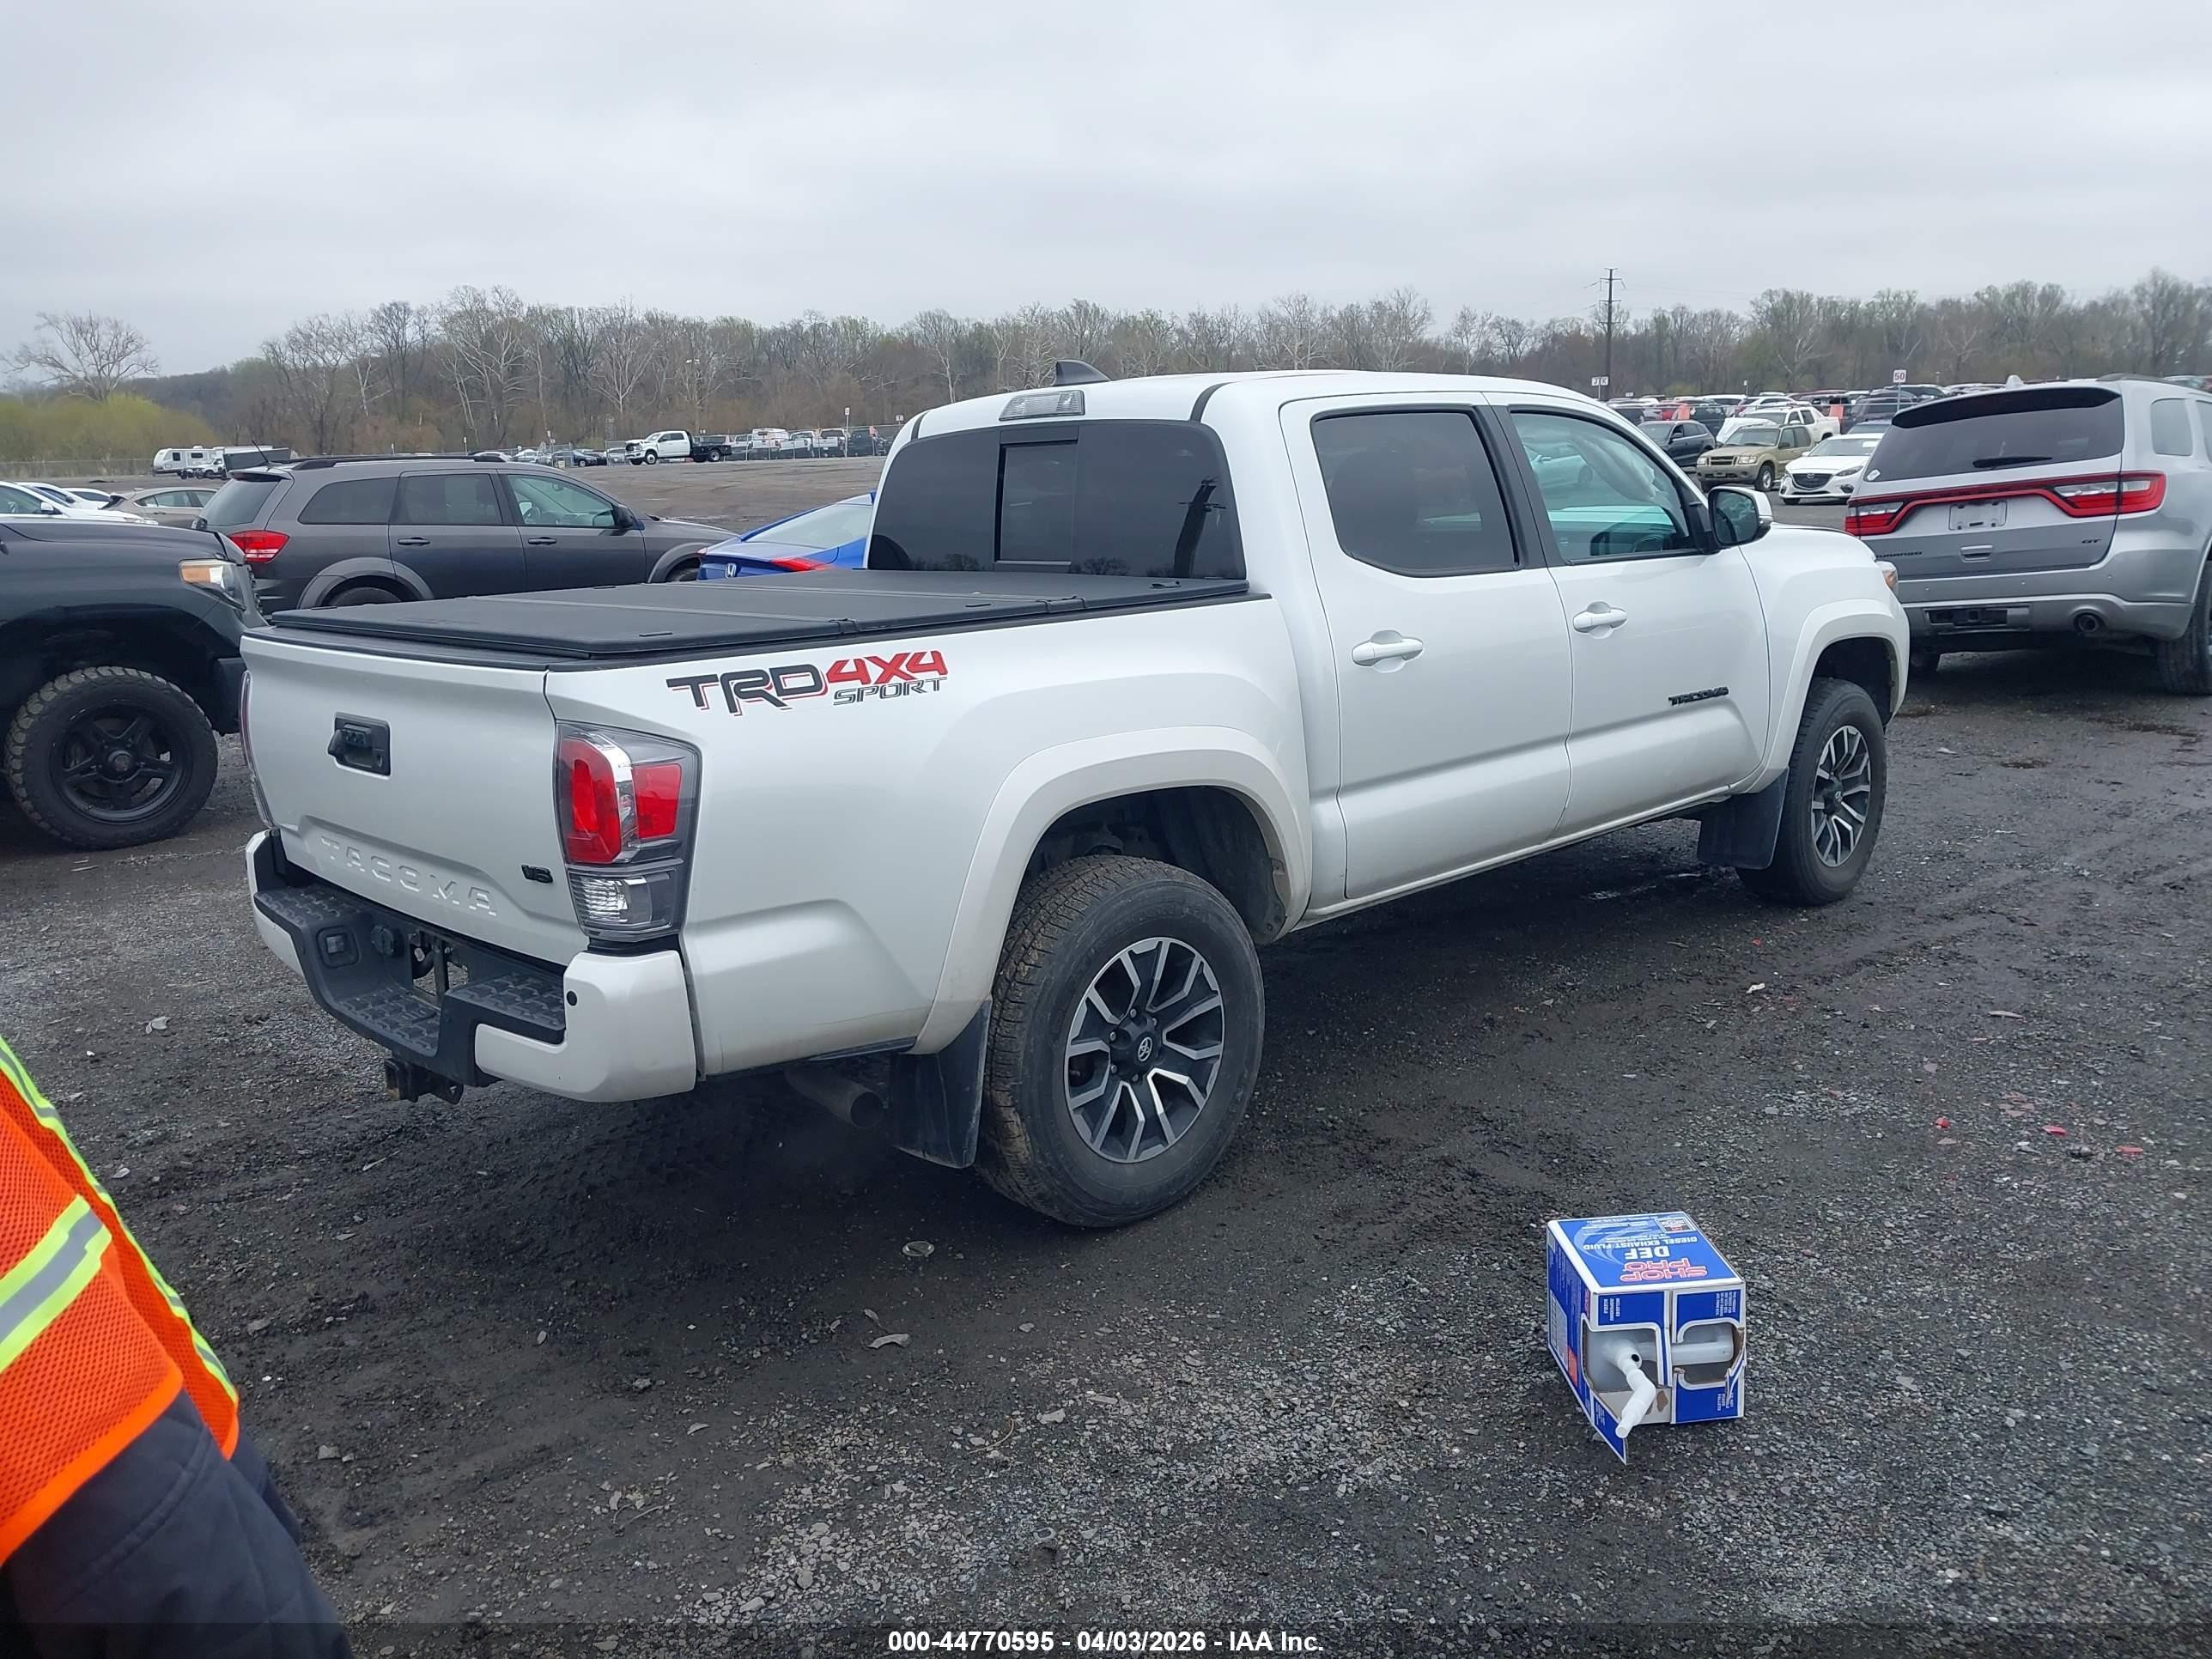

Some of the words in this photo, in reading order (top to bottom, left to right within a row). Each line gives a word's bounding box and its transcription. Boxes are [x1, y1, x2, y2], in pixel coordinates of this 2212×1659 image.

[1895, 372, 1905, 380] 50
[665, 663, 828, 716] TRD
[833, 677, 949, 706] SPORT
[320, 836, 497, 917] TACOMA
[521, 864, 553, 883] V6
[1583, 1243, 1613, 1251] FLUID
[1615, 1238, 1661, 1249] EXHAUST
[1660, 1236, 1698, 1246] DIESEL
[1625, 1245, 1670, 1260] DEF
[1624, 1256, 1692, 1272] PRO
[1620, 1266, 1709, 1283] SHOP
